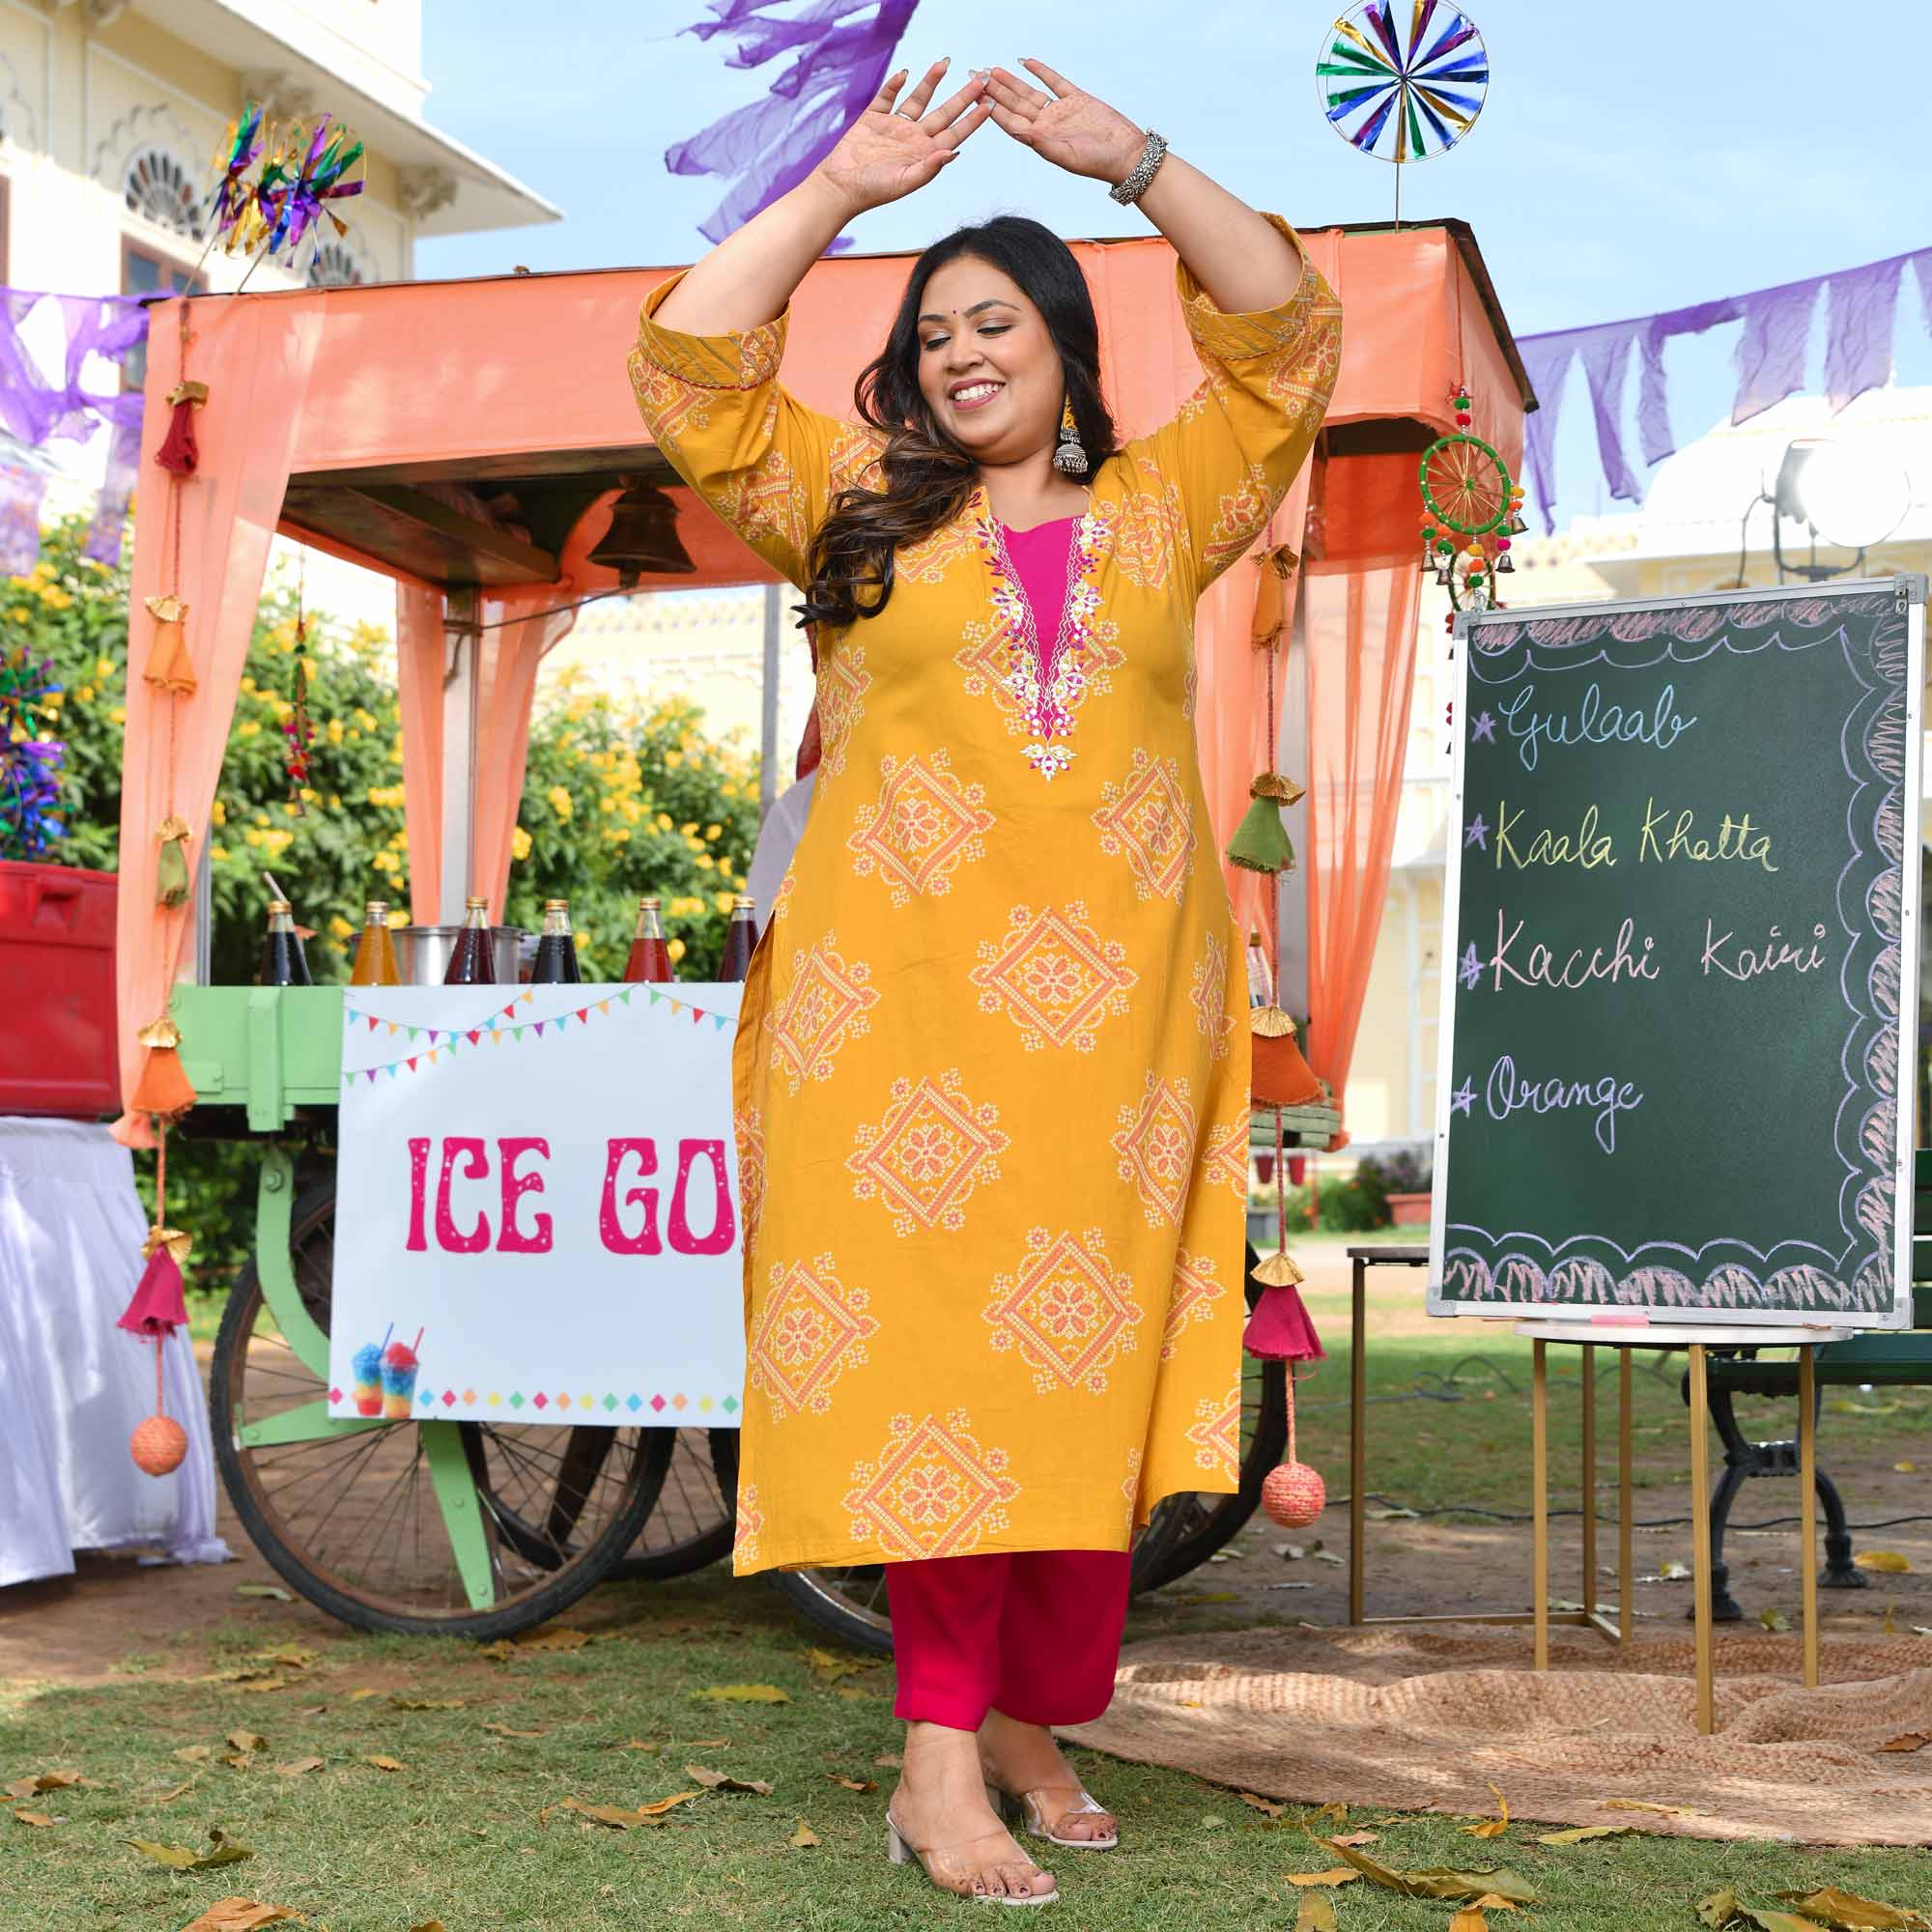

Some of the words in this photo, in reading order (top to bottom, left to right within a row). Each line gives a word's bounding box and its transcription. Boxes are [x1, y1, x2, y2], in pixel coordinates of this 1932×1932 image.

[1498, 682, 1697, 772] Gulaab
[1495, 800, 1617, 870] Kaala
[1639, 796, 1780, 872] Khatta
[1490, 909, 1661, 992] Kacchi
[1701, 918, 1827, 980] Kairi
[1487, 1055, 1644, 1154] Orange
[406, 1136, 554, 1254] ICE
[599, 1137, 742, 1256] GO
